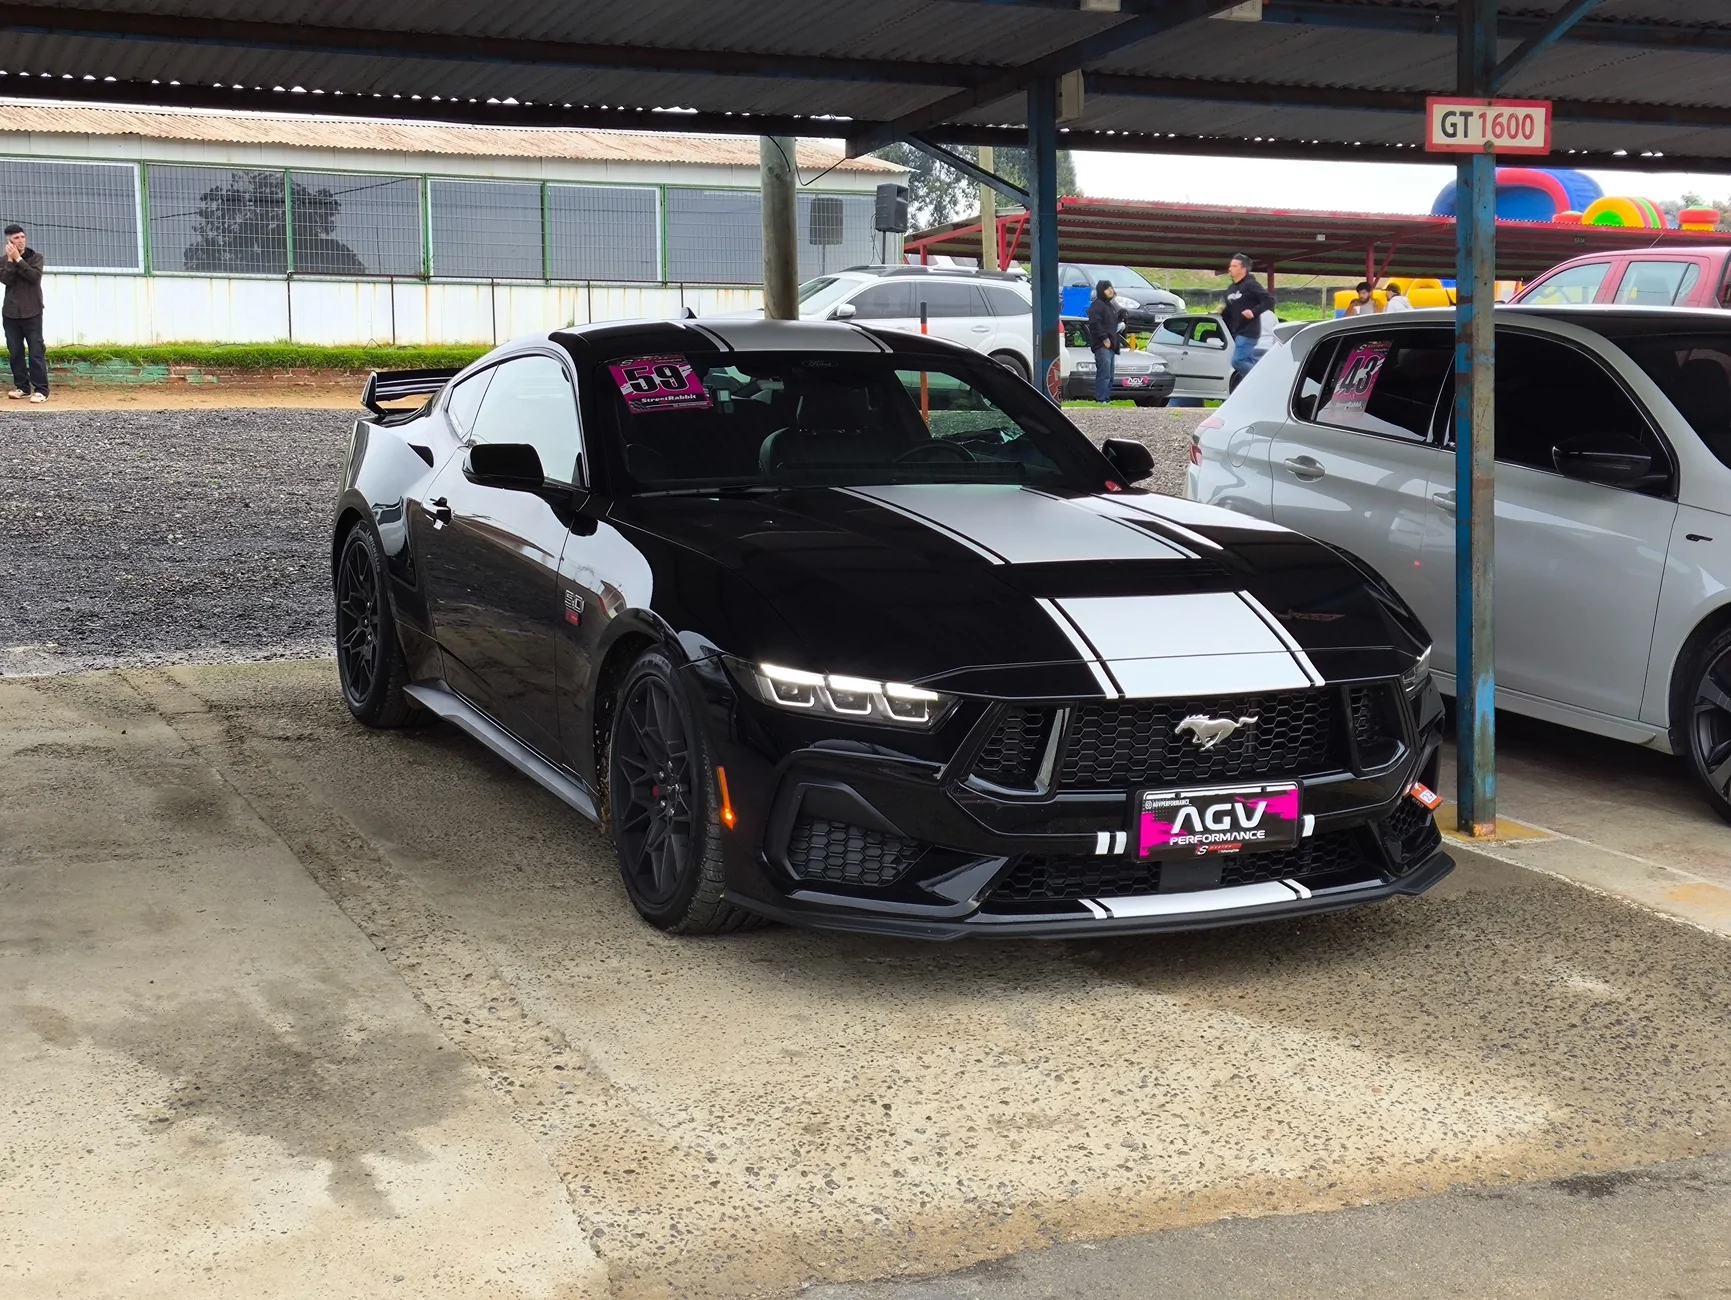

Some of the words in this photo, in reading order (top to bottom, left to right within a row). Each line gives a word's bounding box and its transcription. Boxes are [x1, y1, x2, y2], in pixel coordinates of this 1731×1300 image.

[1440, 110, 1473, 139] GT
[1478, 112, 1535, 140] 1600
[621, 363, 690, 394] 59
[1340, 355, 1380, 394] 43
[641, 393, 697, 404] StreetRabbit
[1171, 800, 1268, 834] AGV
[1169, 829, 1266, 846] PERFORMANCE
